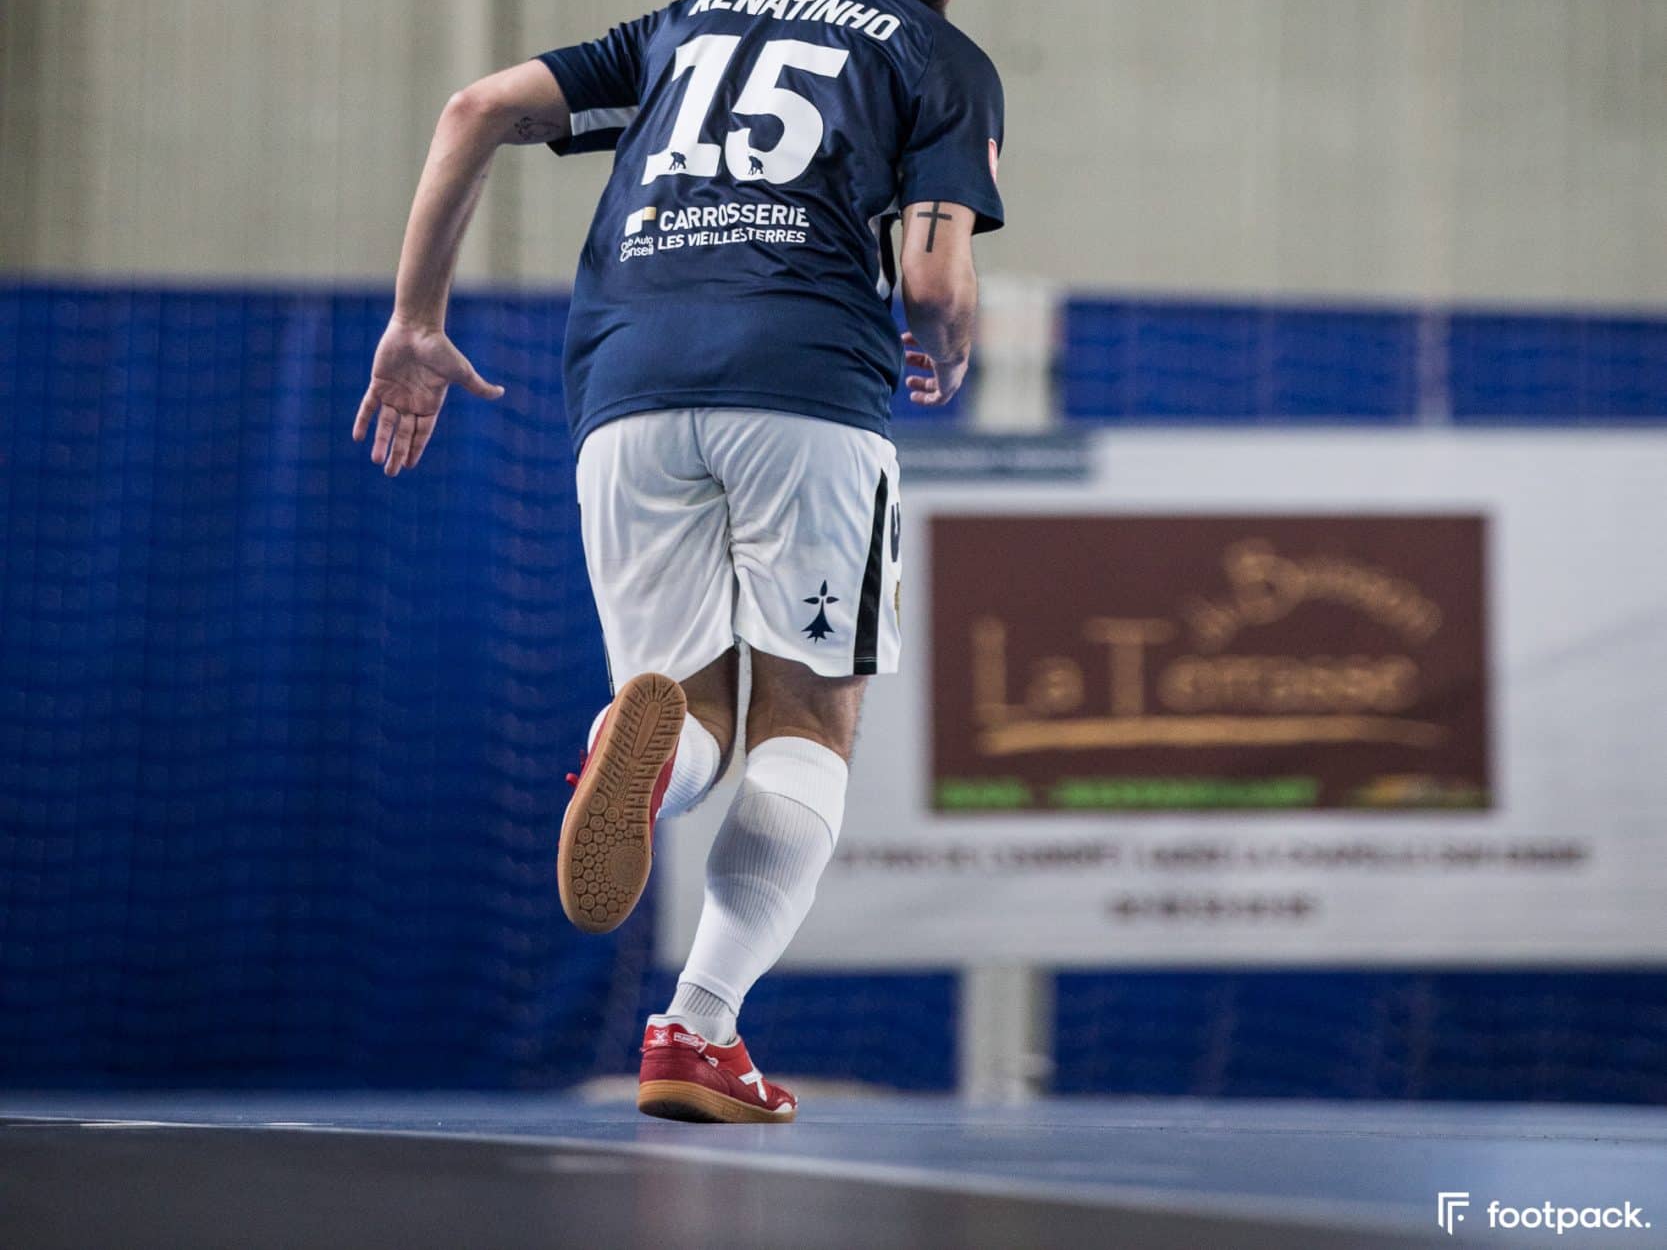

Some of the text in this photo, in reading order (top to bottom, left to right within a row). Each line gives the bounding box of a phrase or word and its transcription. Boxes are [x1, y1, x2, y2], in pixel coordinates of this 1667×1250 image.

[641, 34, 850, 185] 15
[659, 203, 811, 232] CARROSSERIE
[658, 234, 684, 250] LES
